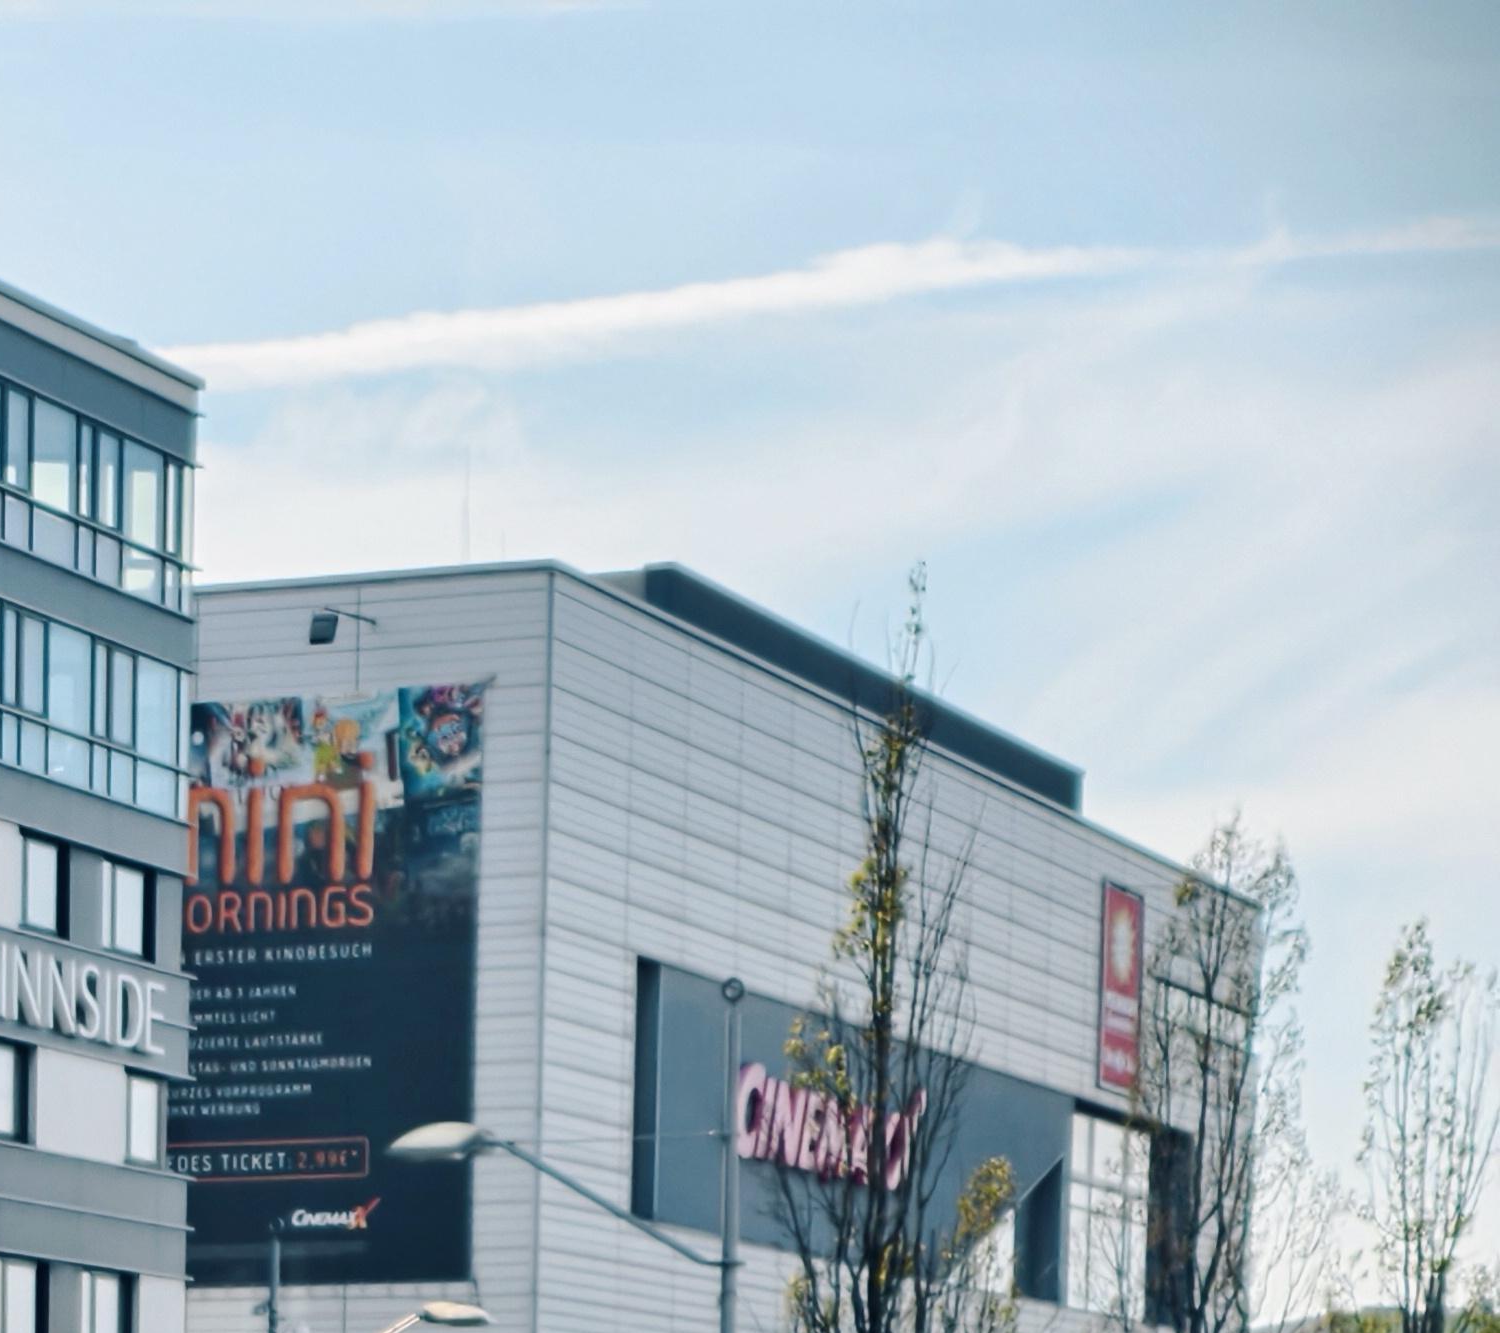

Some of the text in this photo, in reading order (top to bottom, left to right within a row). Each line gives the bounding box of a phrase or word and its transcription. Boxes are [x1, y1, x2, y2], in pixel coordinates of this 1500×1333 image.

[195, 949, 257, 966] ERSTER
[265, 943, 373, 961] KINOBESUCH
[249, 984, 297, 998] JAHREN
[240, 1010, 276, 1023] LICHT
[230, 1059, 257, 1073] UND
[261, 1056, 373, 1071] SONNTAGMORGEN
[169, 1083, 312, 1099] URZES VORPROGRAMM
[201, 1103, 261, 1116] WERBUNG
